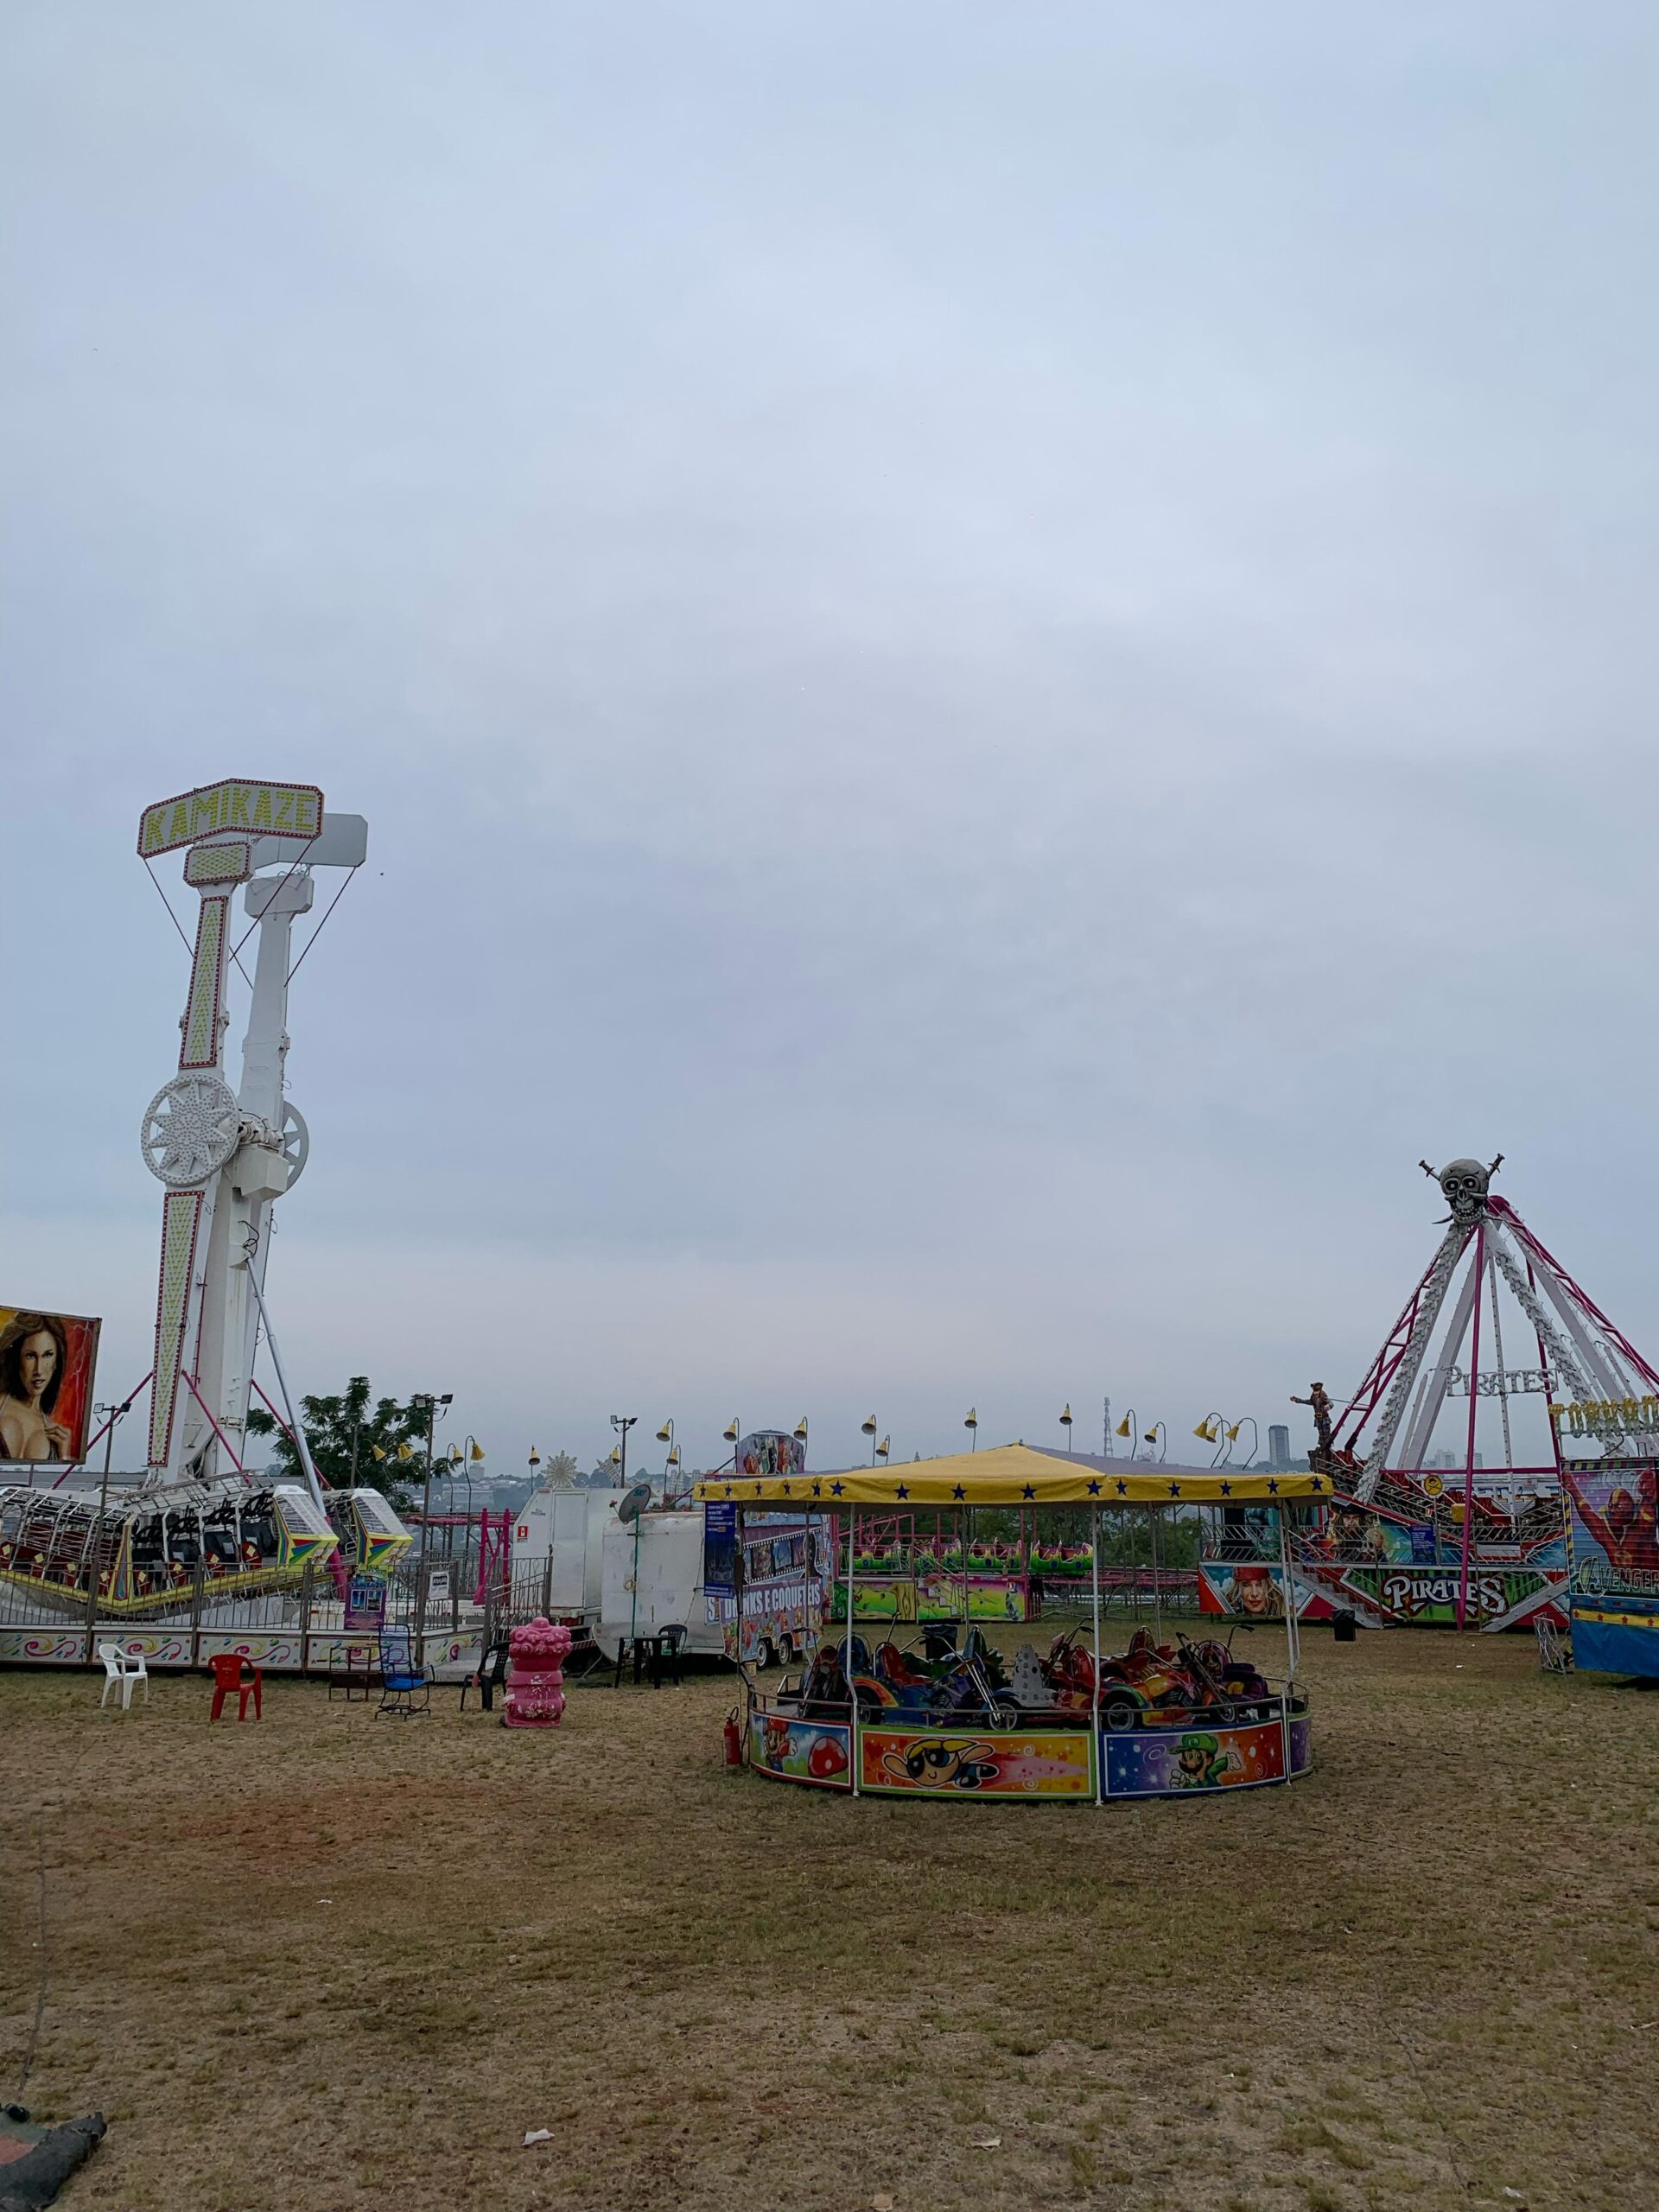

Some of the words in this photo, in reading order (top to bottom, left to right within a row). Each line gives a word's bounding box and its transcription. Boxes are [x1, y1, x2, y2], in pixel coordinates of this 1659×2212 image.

[145, 787, 316, 850] KAMIKAZE
[1441, 1365, 1556, 1396] PIRATES
[724, 1591, 763, 1619] DRNKS
[765, 1590, 771, 1612] E
[1383, 1575, 1506, 1614] PIRATES
